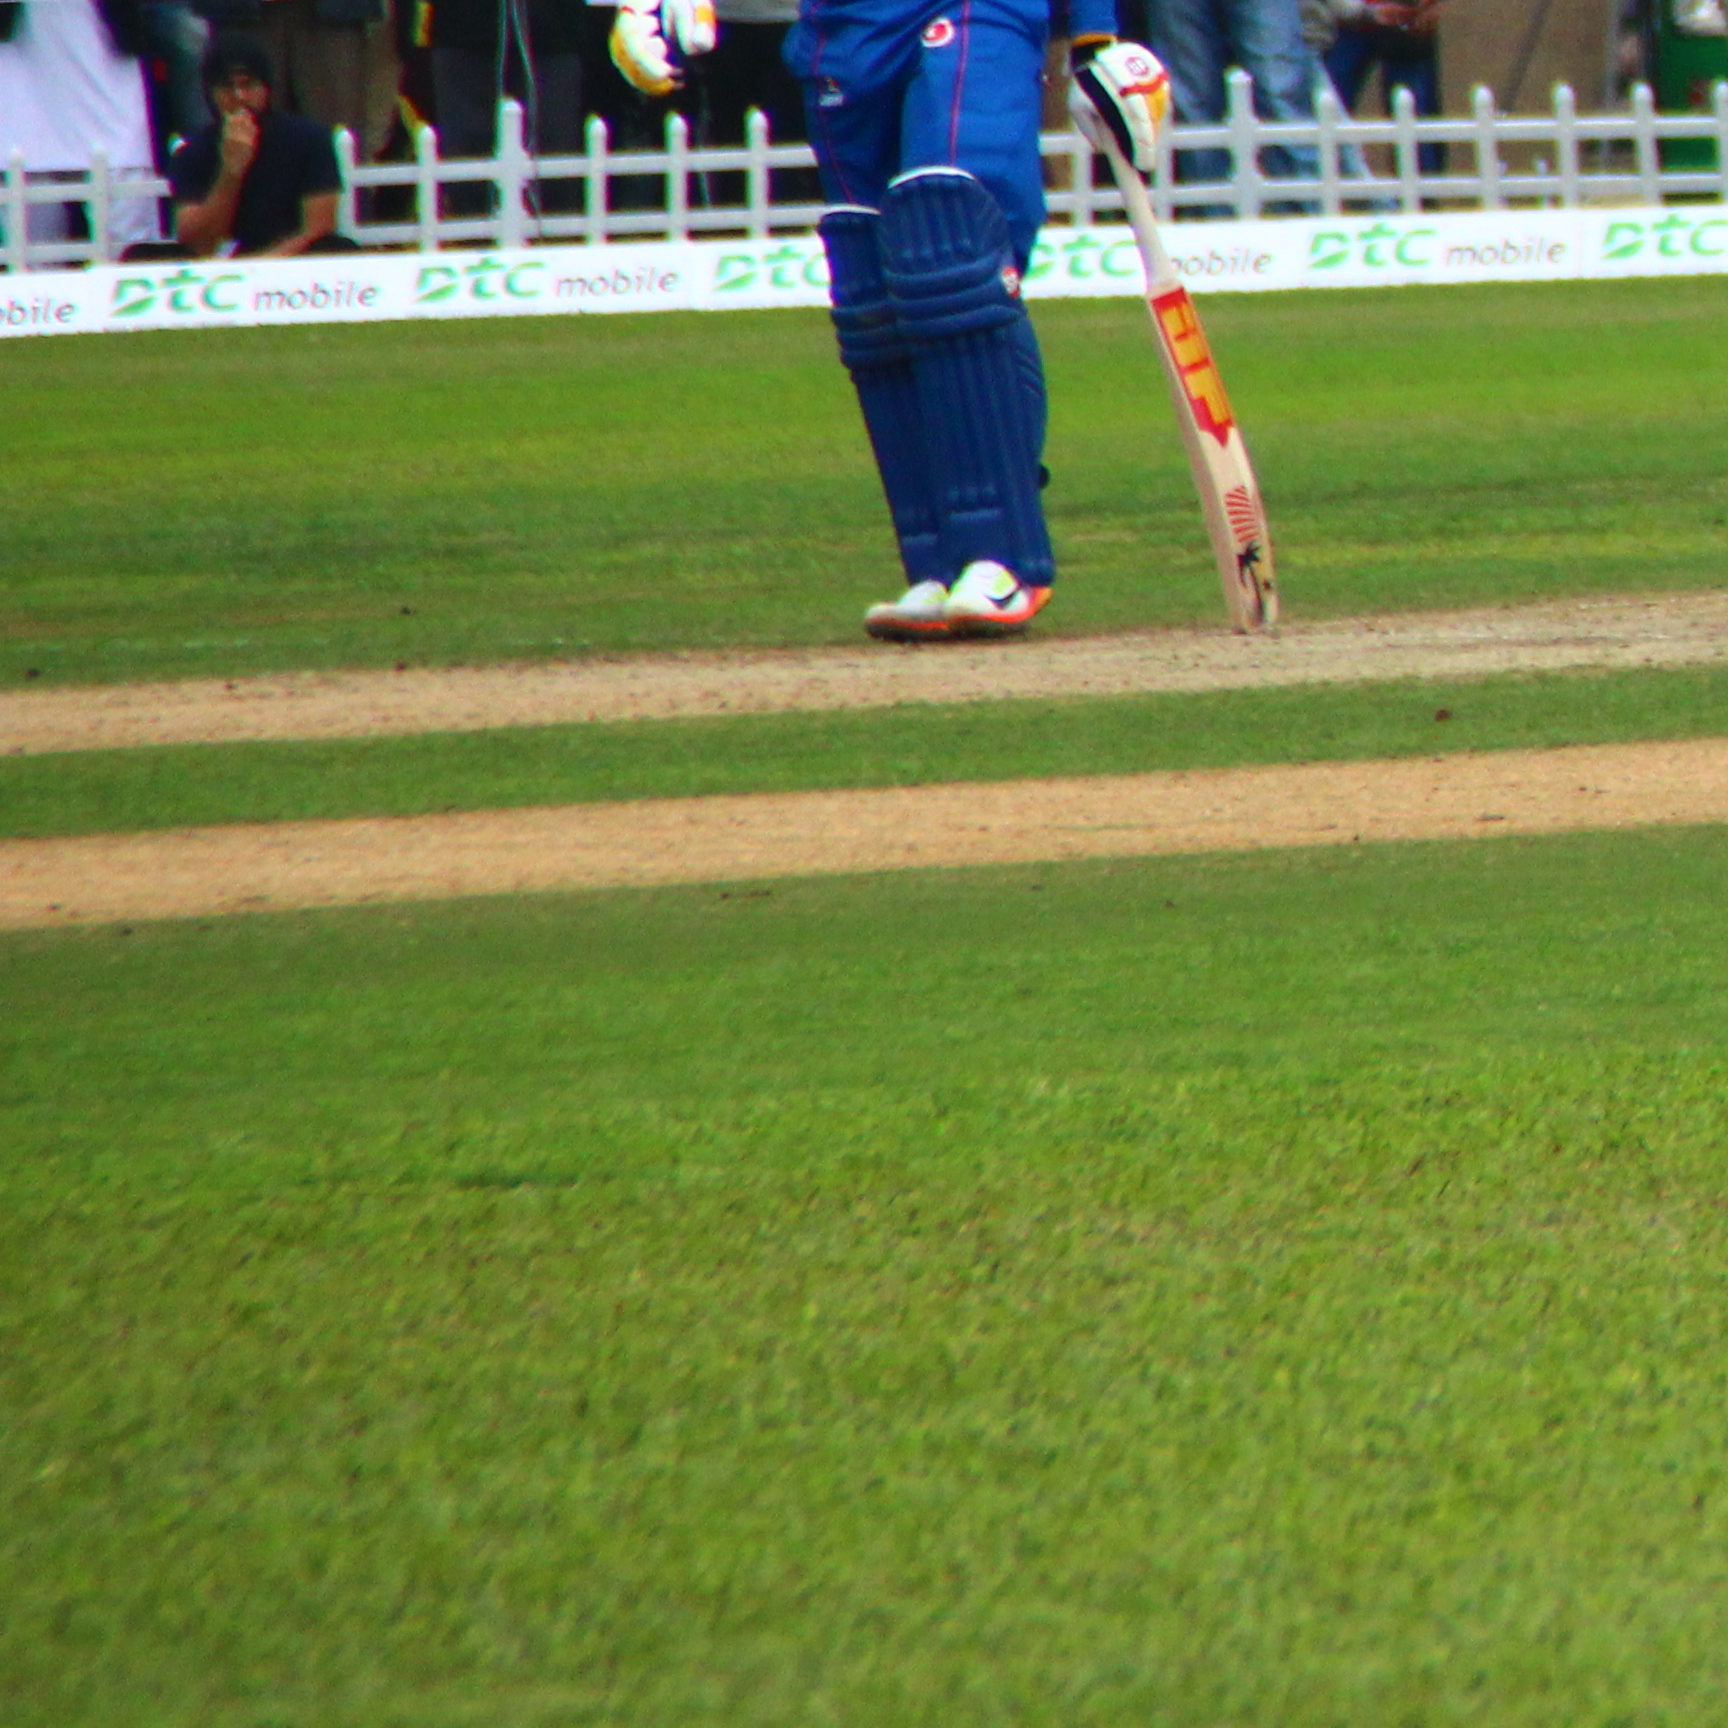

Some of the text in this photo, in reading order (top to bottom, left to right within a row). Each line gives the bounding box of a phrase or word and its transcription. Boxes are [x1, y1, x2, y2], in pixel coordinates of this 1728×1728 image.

[1446, 228, 1568, 269] mobile
[253, 279, 380, 314] mobile
[554, 265, 682, 300] mobile
